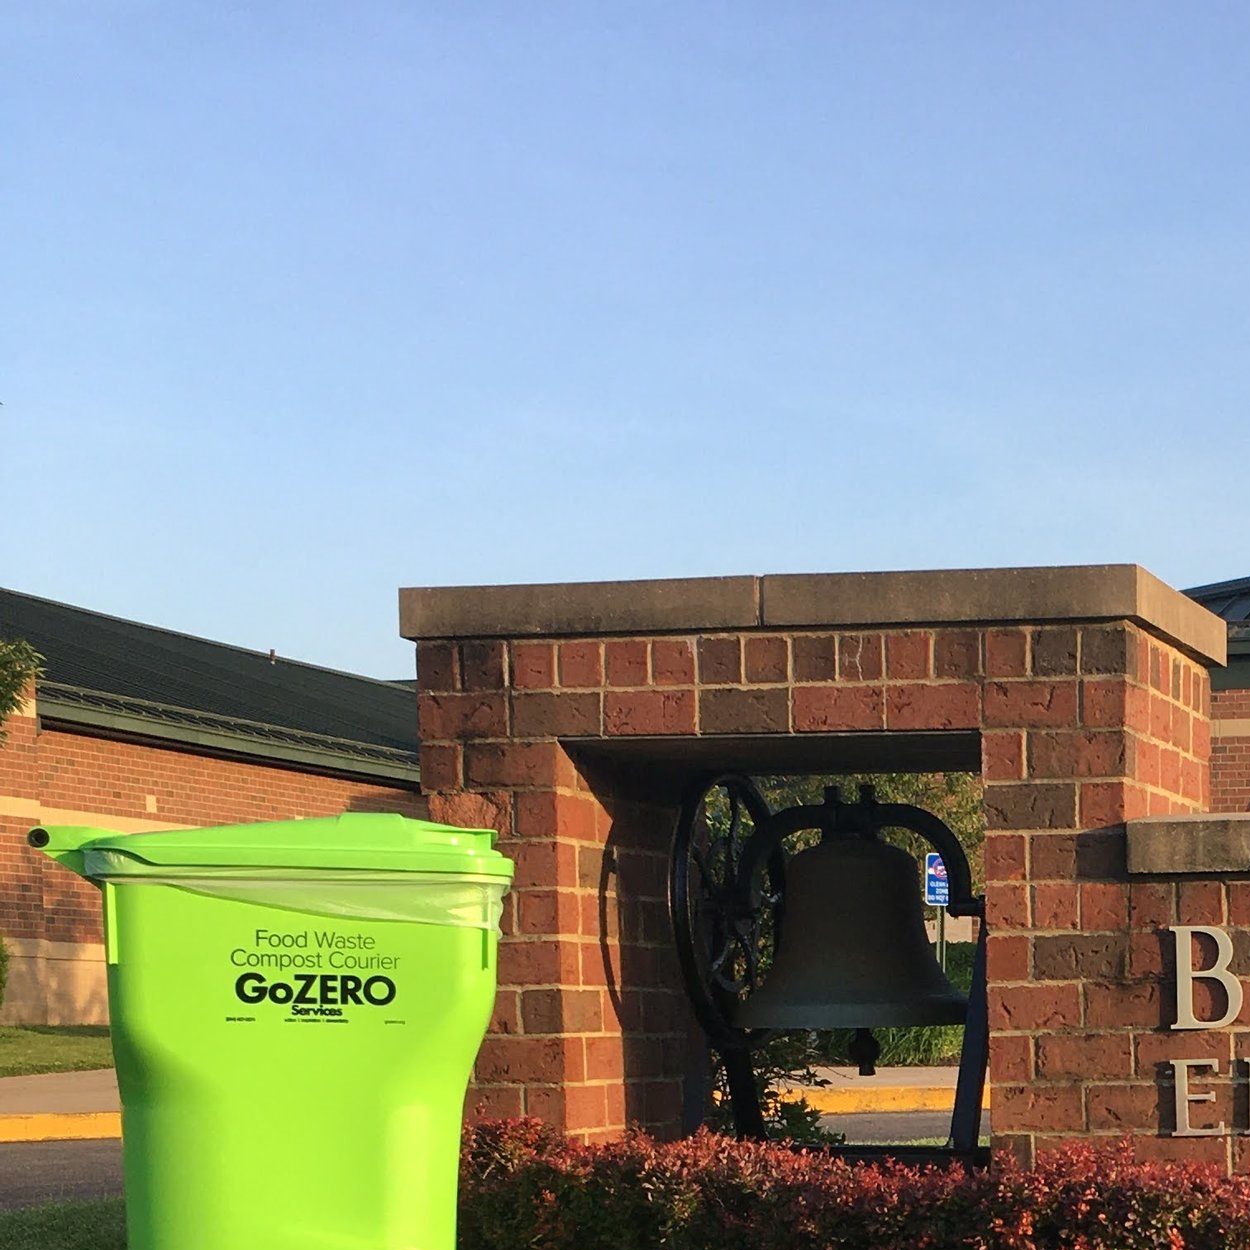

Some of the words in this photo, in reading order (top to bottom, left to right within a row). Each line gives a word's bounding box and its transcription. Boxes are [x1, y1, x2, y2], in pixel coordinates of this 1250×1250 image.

[255, 929, 308, 948] Food
[314, 931, 376, 950] Waste
[230, 948, 323, 971] Compost
[328, 951, 401, 970] Courier
[235, 972, 397, 1006] GoZERO
[291, 1004, 343, 1017] Services
